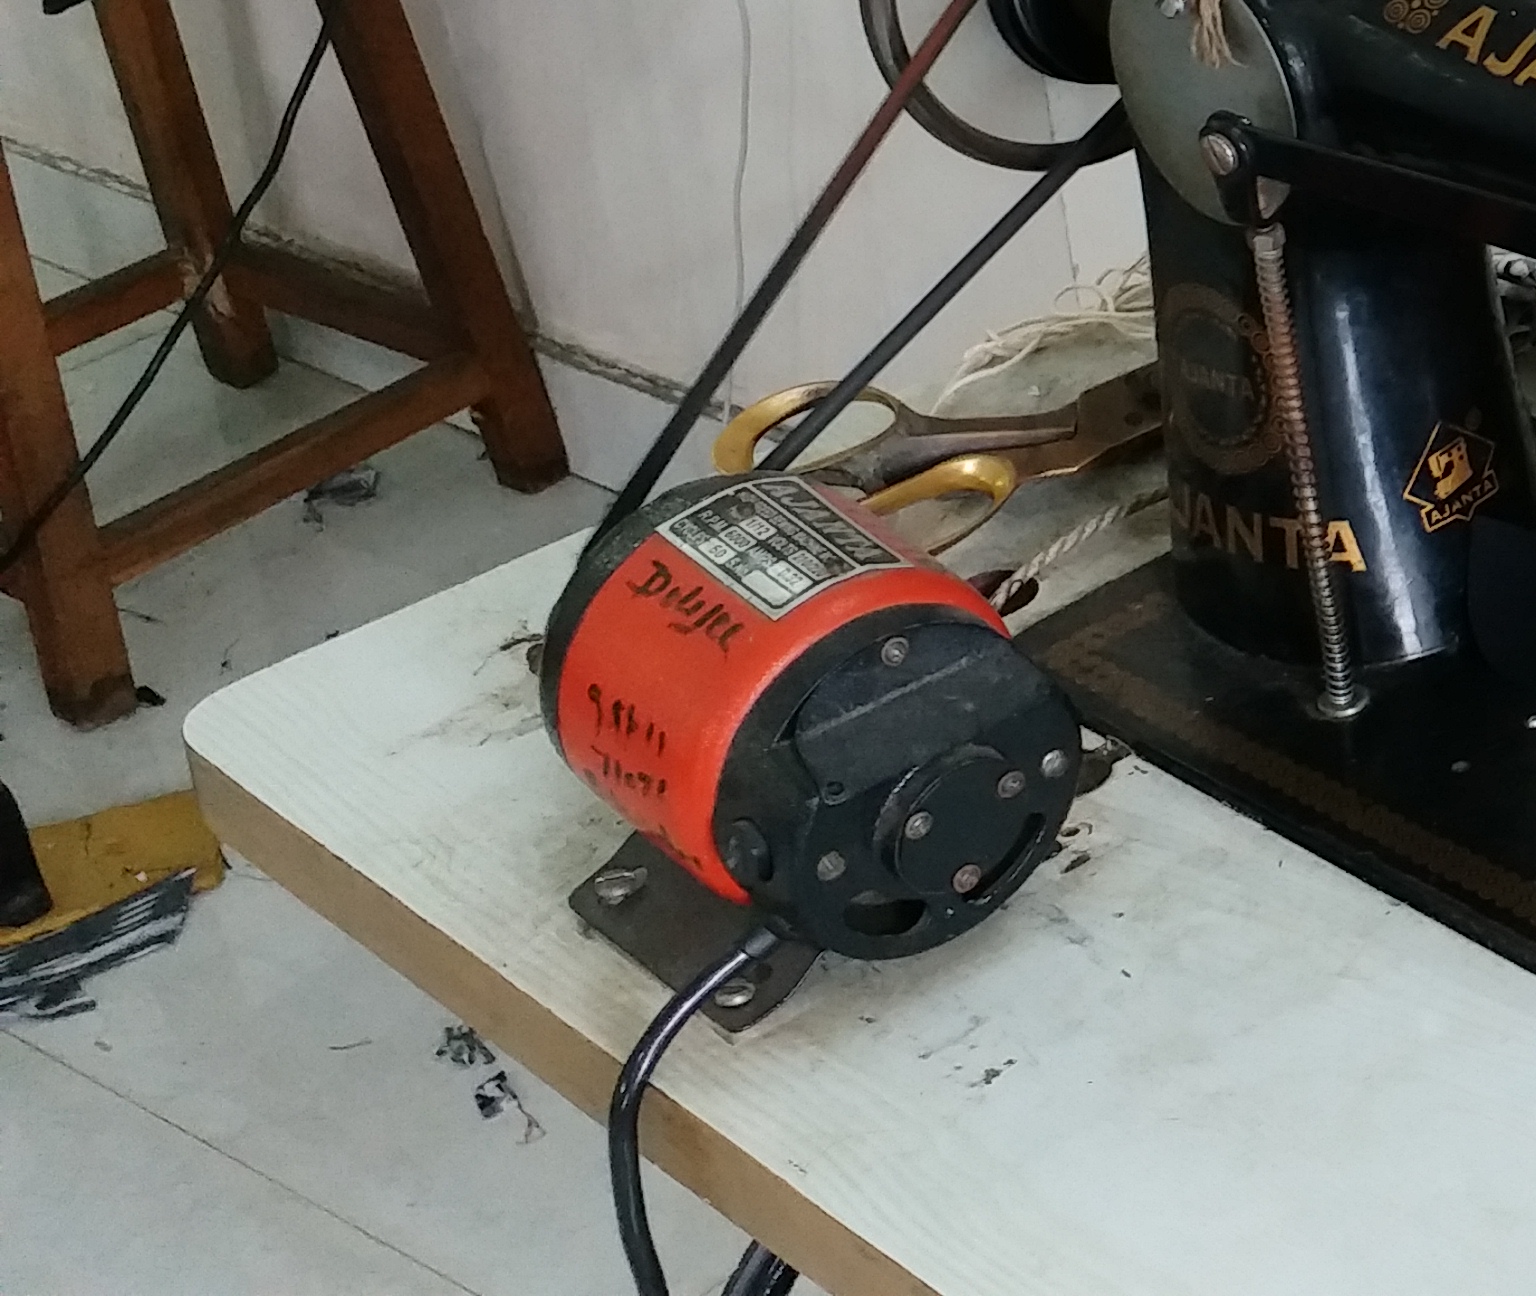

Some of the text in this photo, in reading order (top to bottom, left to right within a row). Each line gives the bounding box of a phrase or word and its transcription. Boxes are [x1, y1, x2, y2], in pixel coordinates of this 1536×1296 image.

[745, 518, 771, 536] 1/12
[761, 484, 886, 561] AJANTA
[1169, 483, 1367, 572] JANTA
[1430, 479, 1494, 524] AJANTA
